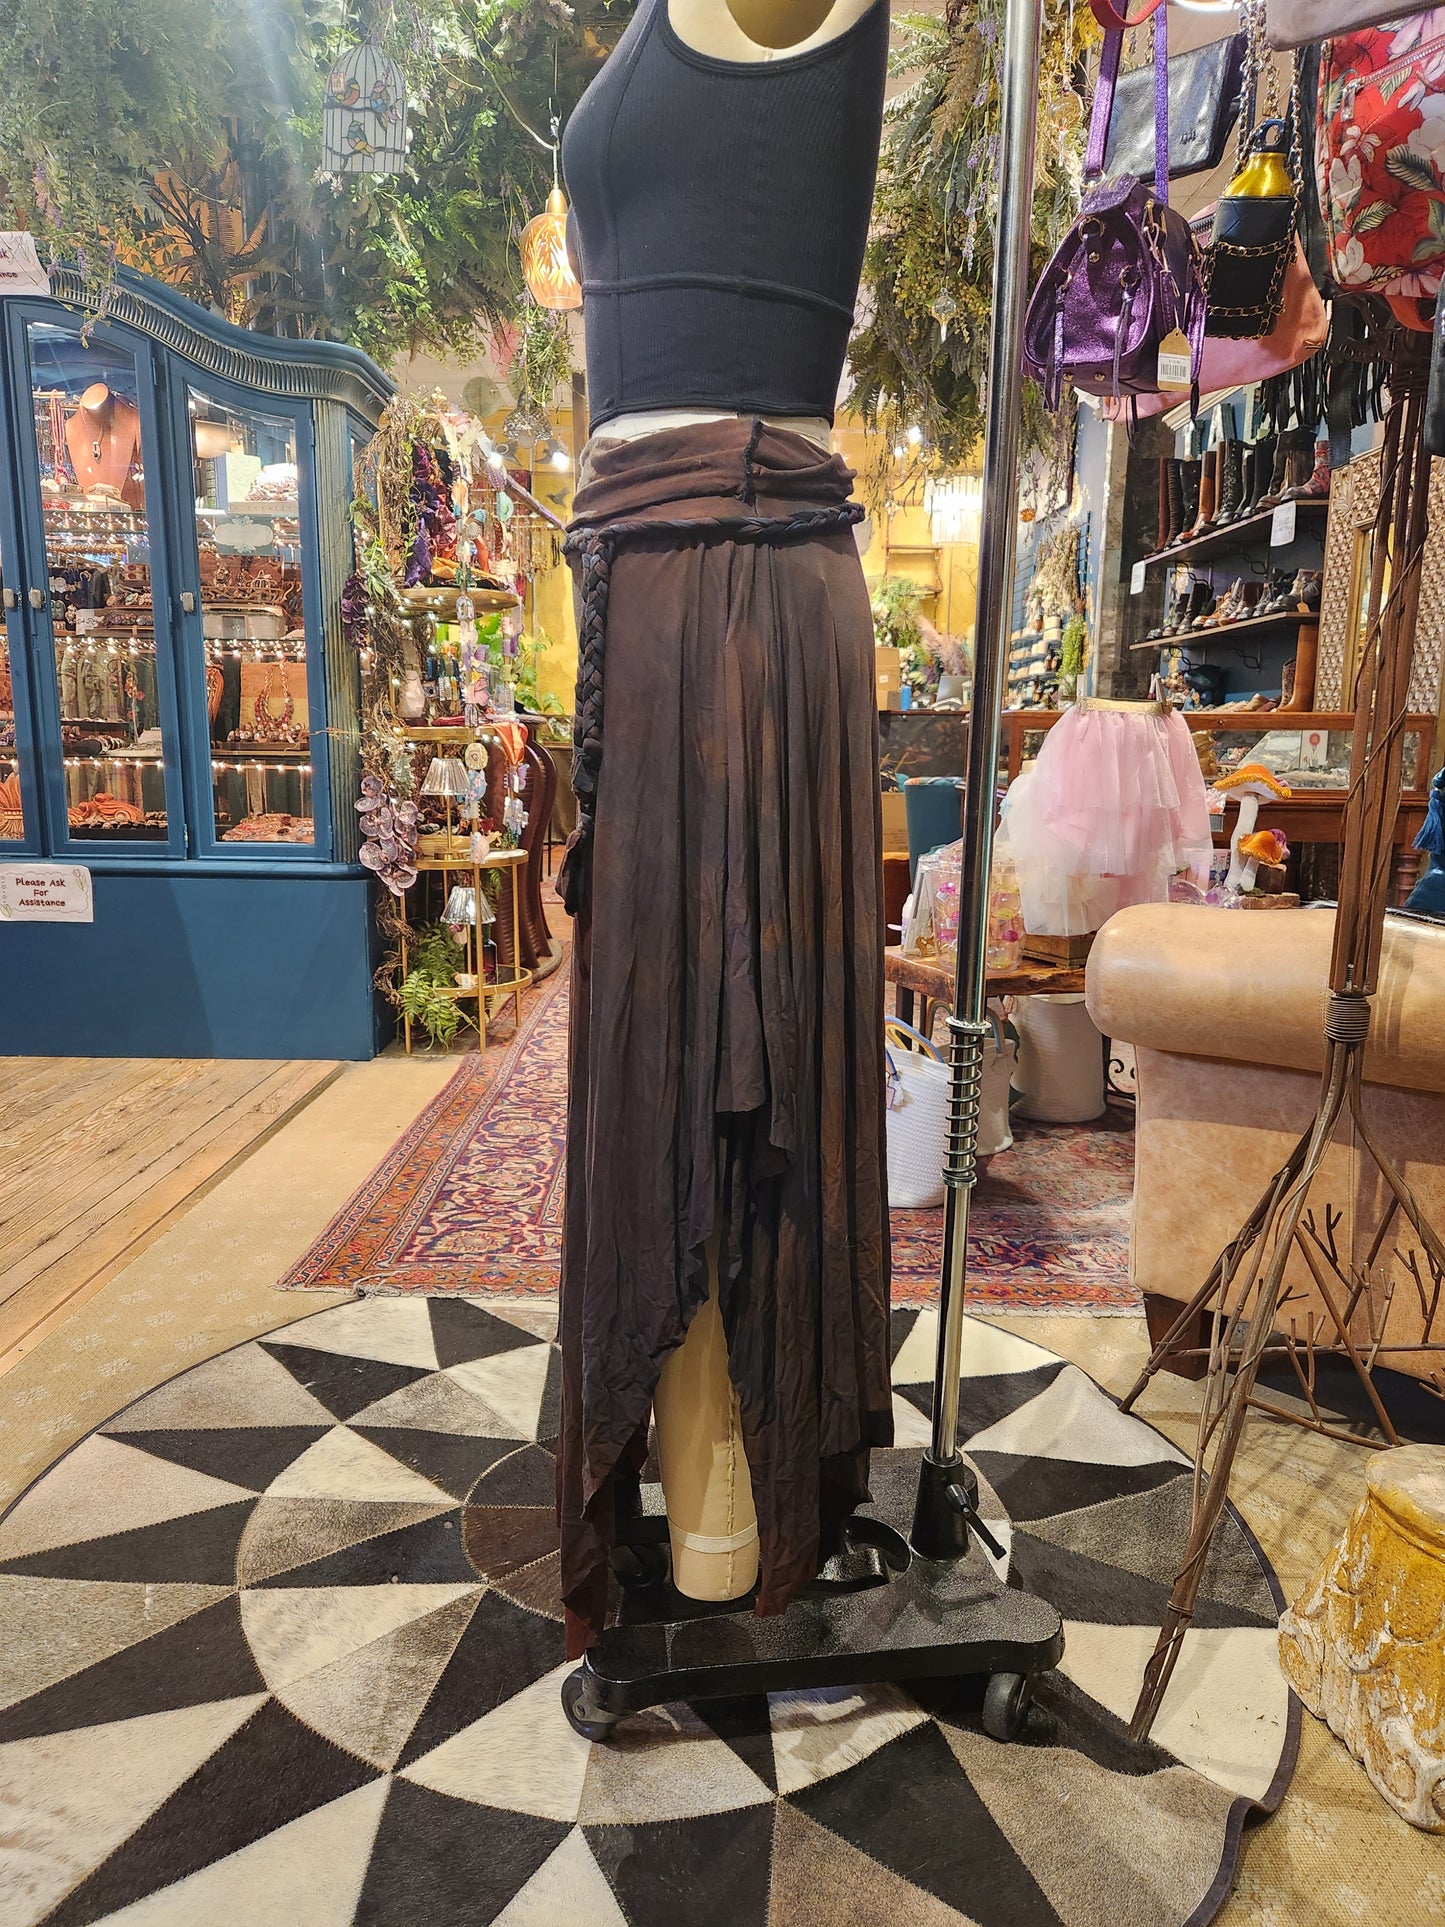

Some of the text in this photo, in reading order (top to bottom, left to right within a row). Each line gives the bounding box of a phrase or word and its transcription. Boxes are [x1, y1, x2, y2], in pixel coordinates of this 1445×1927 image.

[15, 877, 66, 887] Please Ask
[33, 889, 49, 897] For
[19, 899, 66, 907] Assistance
